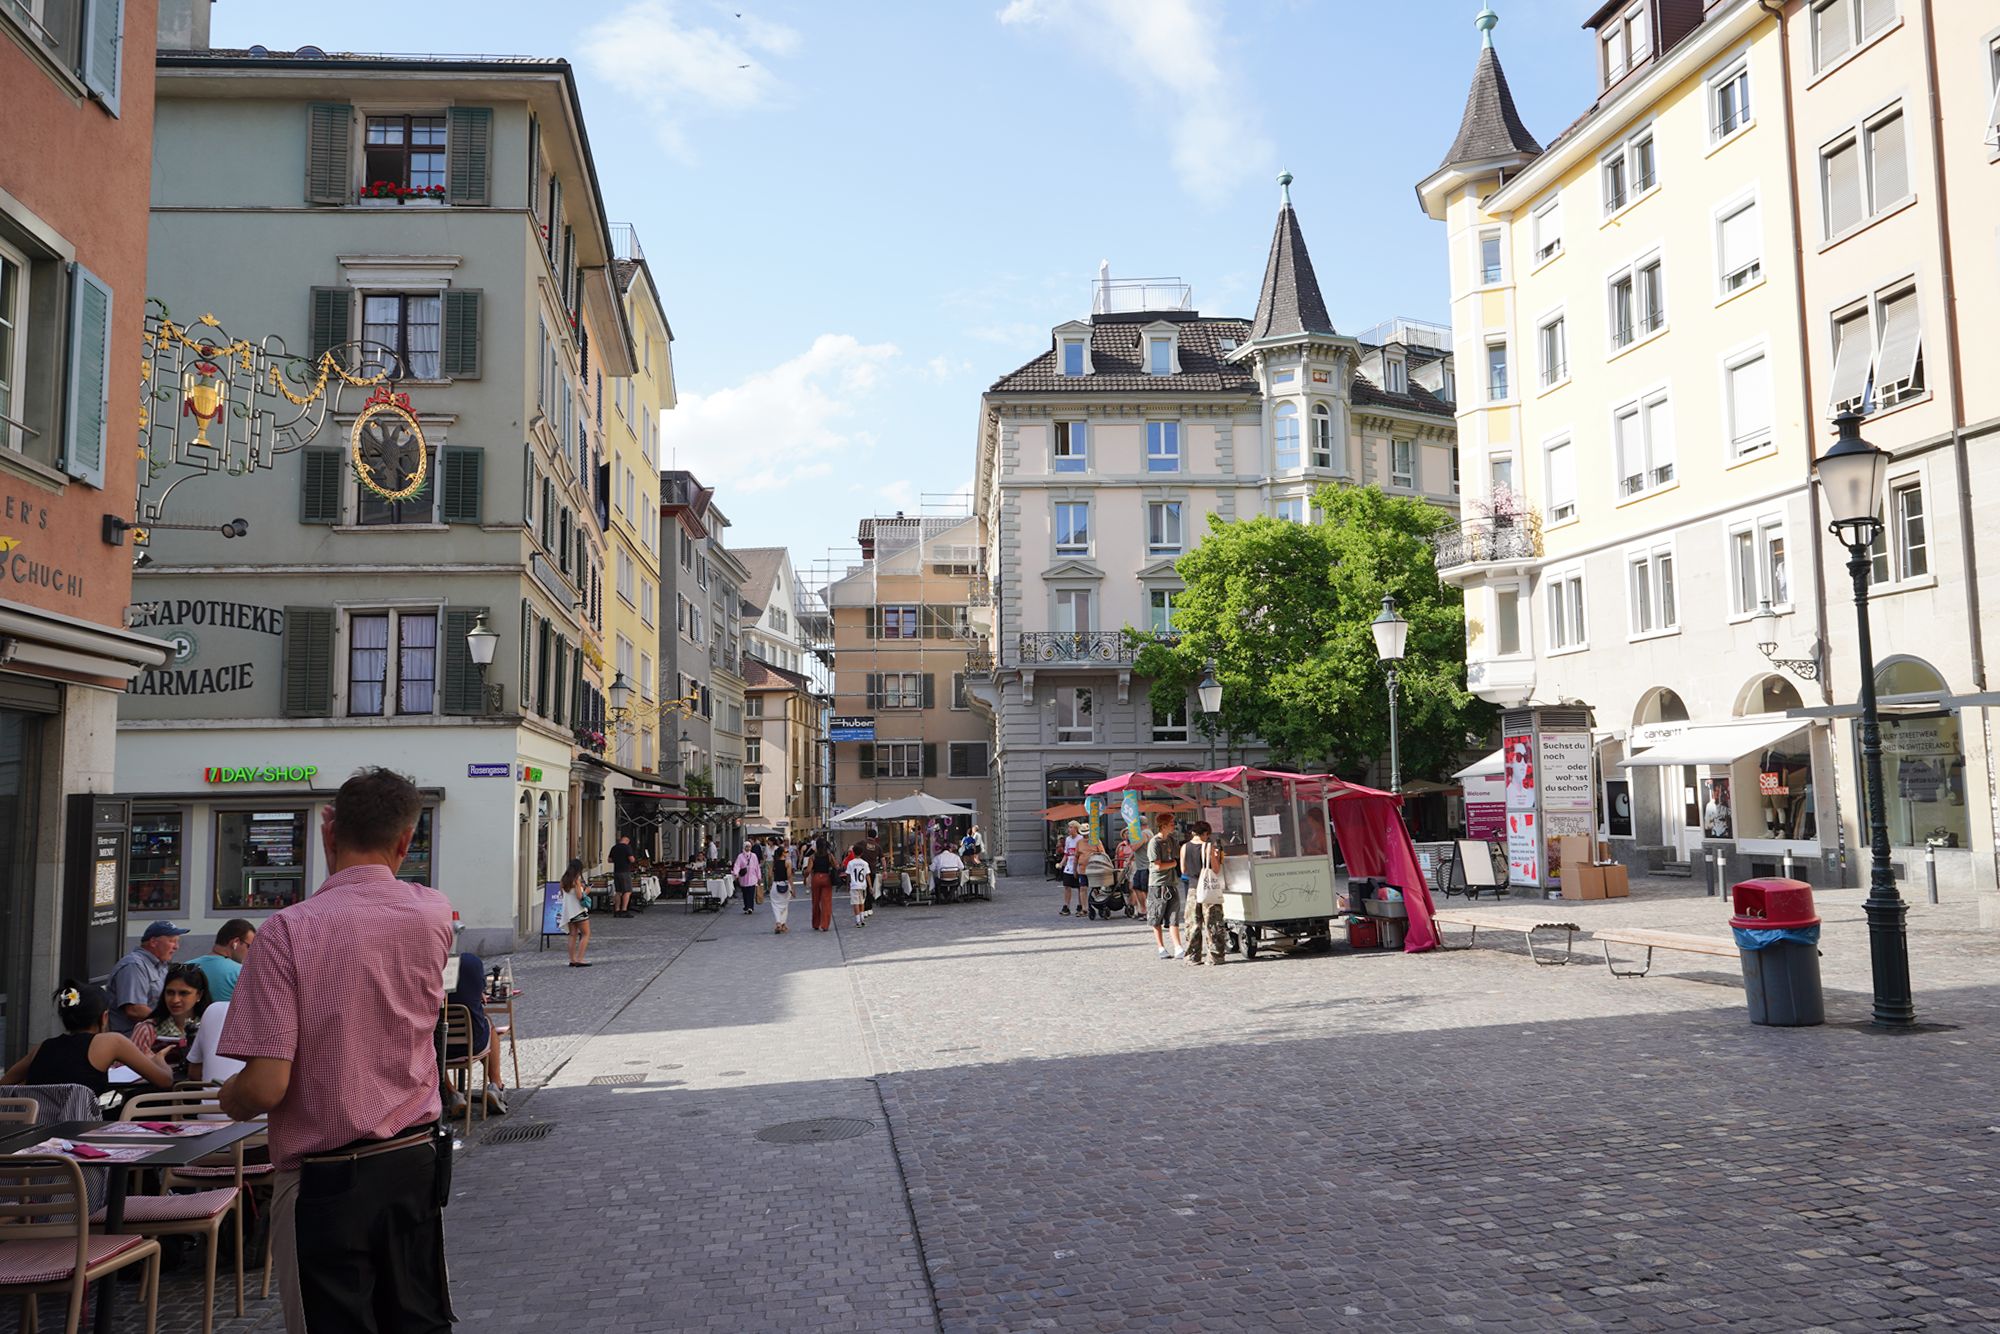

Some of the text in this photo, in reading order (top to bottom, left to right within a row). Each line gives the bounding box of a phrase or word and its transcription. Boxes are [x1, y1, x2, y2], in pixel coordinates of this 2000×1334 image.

[0, 495, 47, 530] ER'S
[11, 553, 83, 598] CHUCHI
[129, 599, 284, 637] ENAPOTHEKE
[126, 662, 254, 696] HARMACIE
[842, 718, 874, 728] huber
[1899, 730, 1938, 740] STREETWEAR
[1543, 742, 1586, 750] Suchst du
[1906, 742, 1951, 752] SWITZERLAND
[470, 765, 508, 777] Rosengasse
[1567, 763, 1588, 771] oder
[1760, 773, 1779, 789] Sale
[1545, 784, 1589, 792] du schon?
[98, 847, 116, 857] MENU
[853, 868, 865, 883] 16
